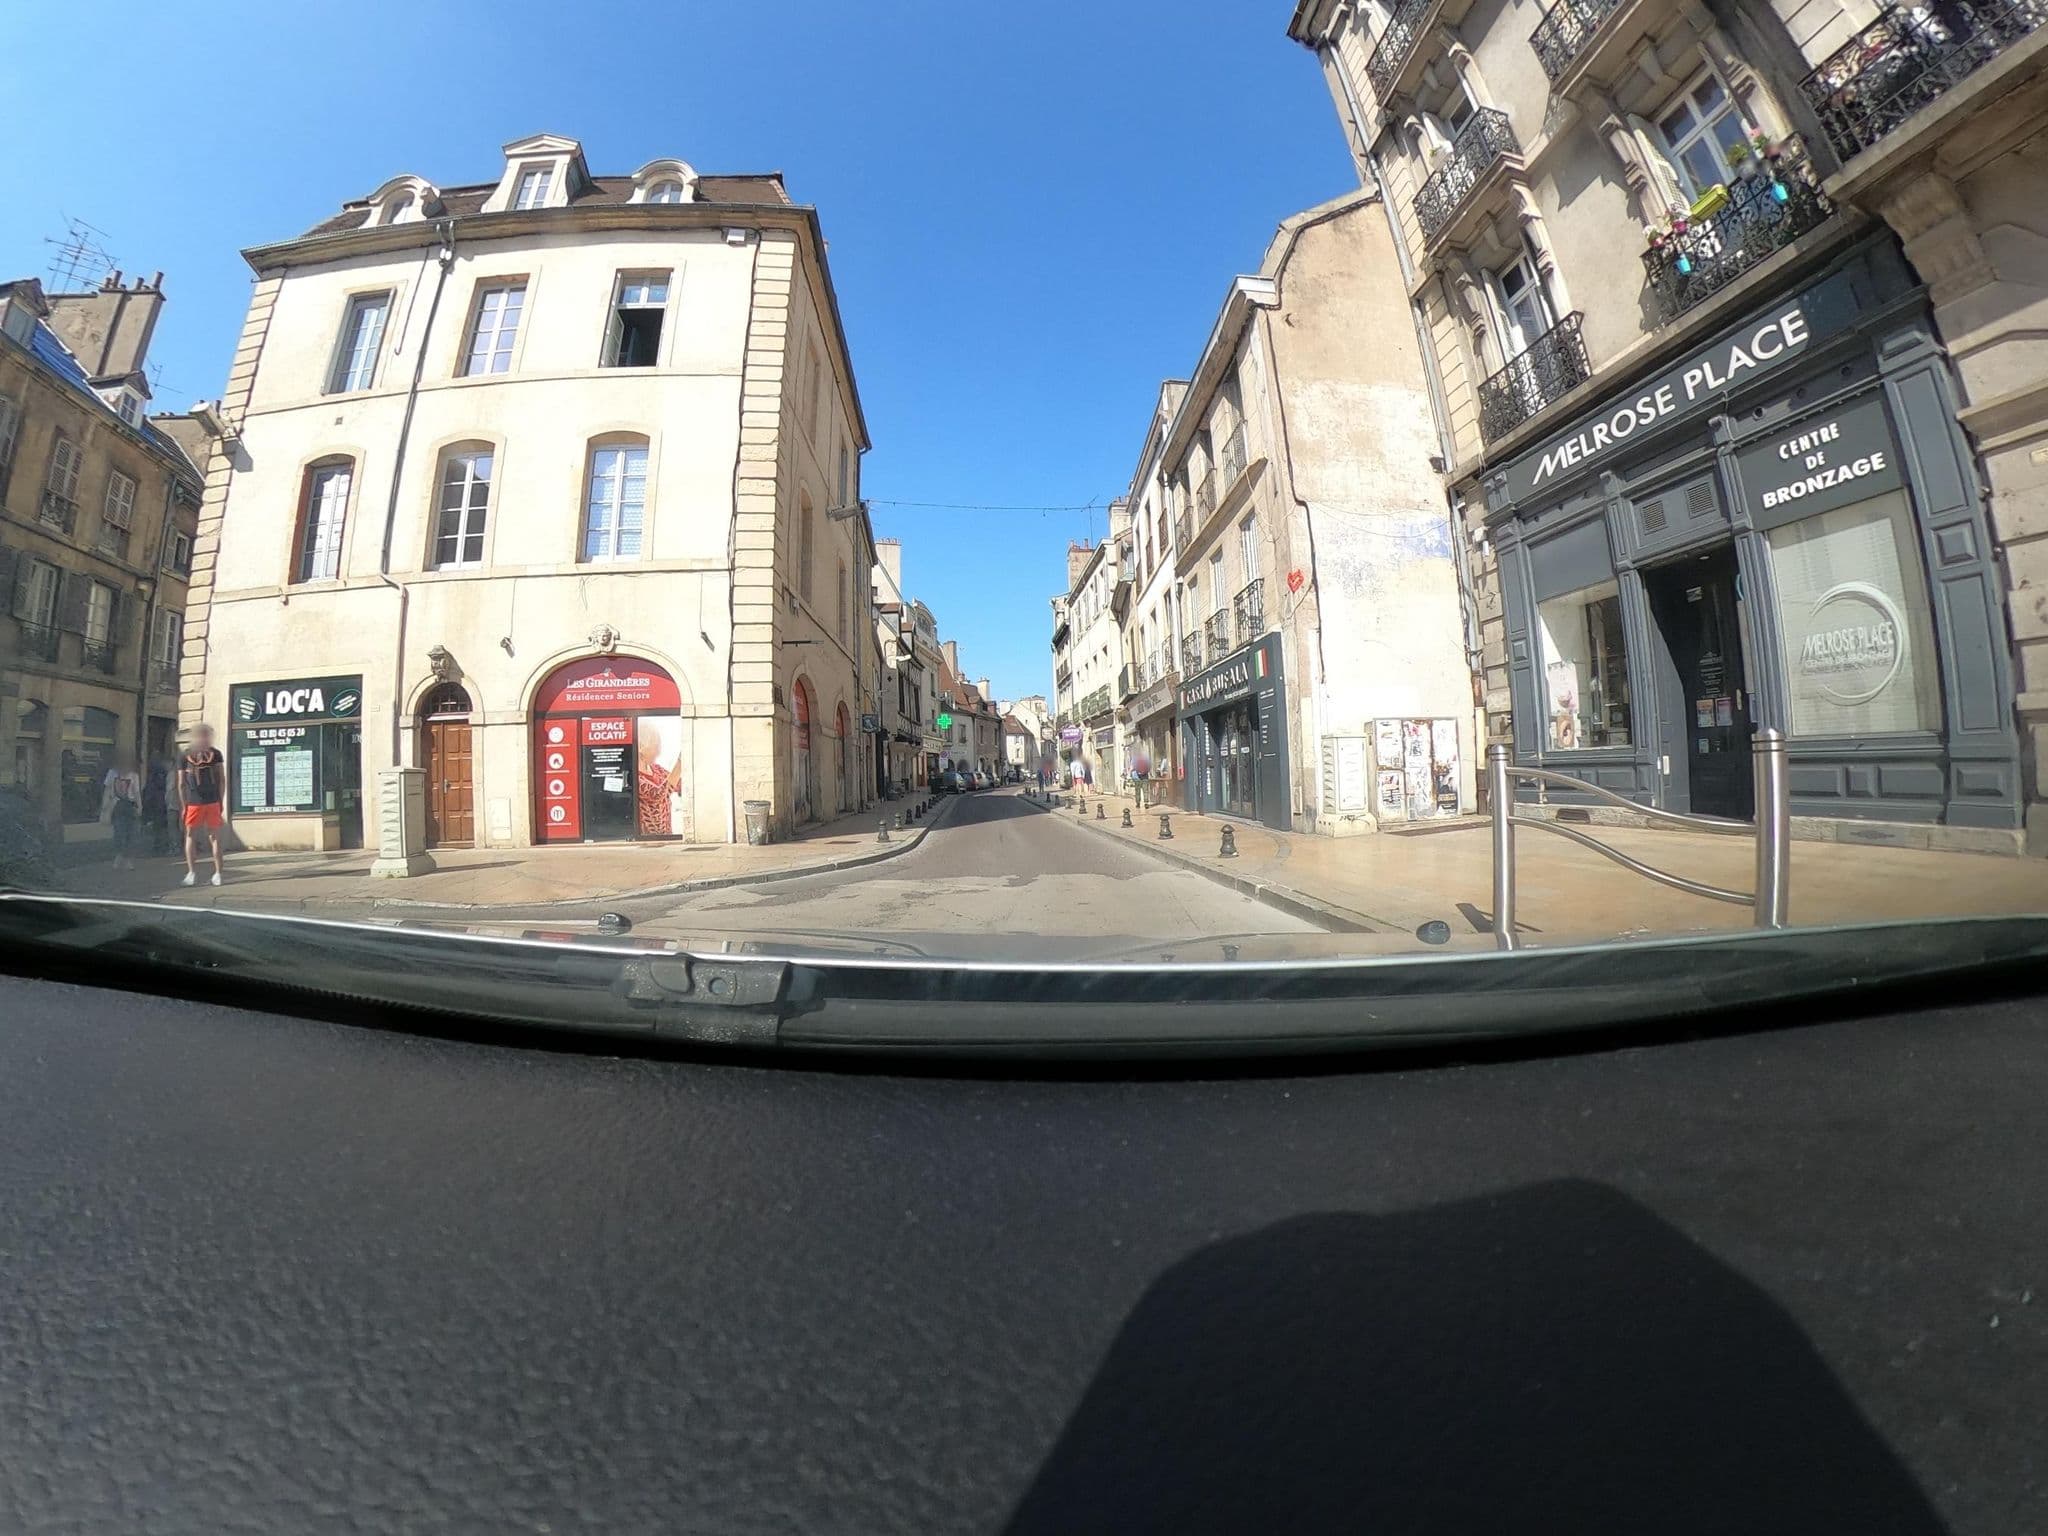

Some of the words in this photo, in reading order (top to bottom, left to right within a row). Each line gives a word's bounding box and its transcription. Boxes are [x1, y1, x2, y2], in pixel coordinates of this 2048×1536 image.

[1532, 384, 1676, 486] MELROSE
[1682, 309, 1809, 400] PLACE
[1779, 422, 1841, 460] CENTRE
[1805, 451, 1826, 470] DE
[1762, 452, 1887, 509] BRONZAGE
[1803, 628, 1856, 658] MELROSE
[1858, 621, 1894, 651] PLACE
[567, 679, 584, 688] LES
[586, 677, 650, 688] GIRANDIÈRES
[265, 688, 325, 715] LOC'A
[566, 692, 614, 701] Résidences
[617, 691, 650, 700] Seniors
[588, 731, 627, 741] LOCATIF
[591, 721, 625, 731] ESPACE
